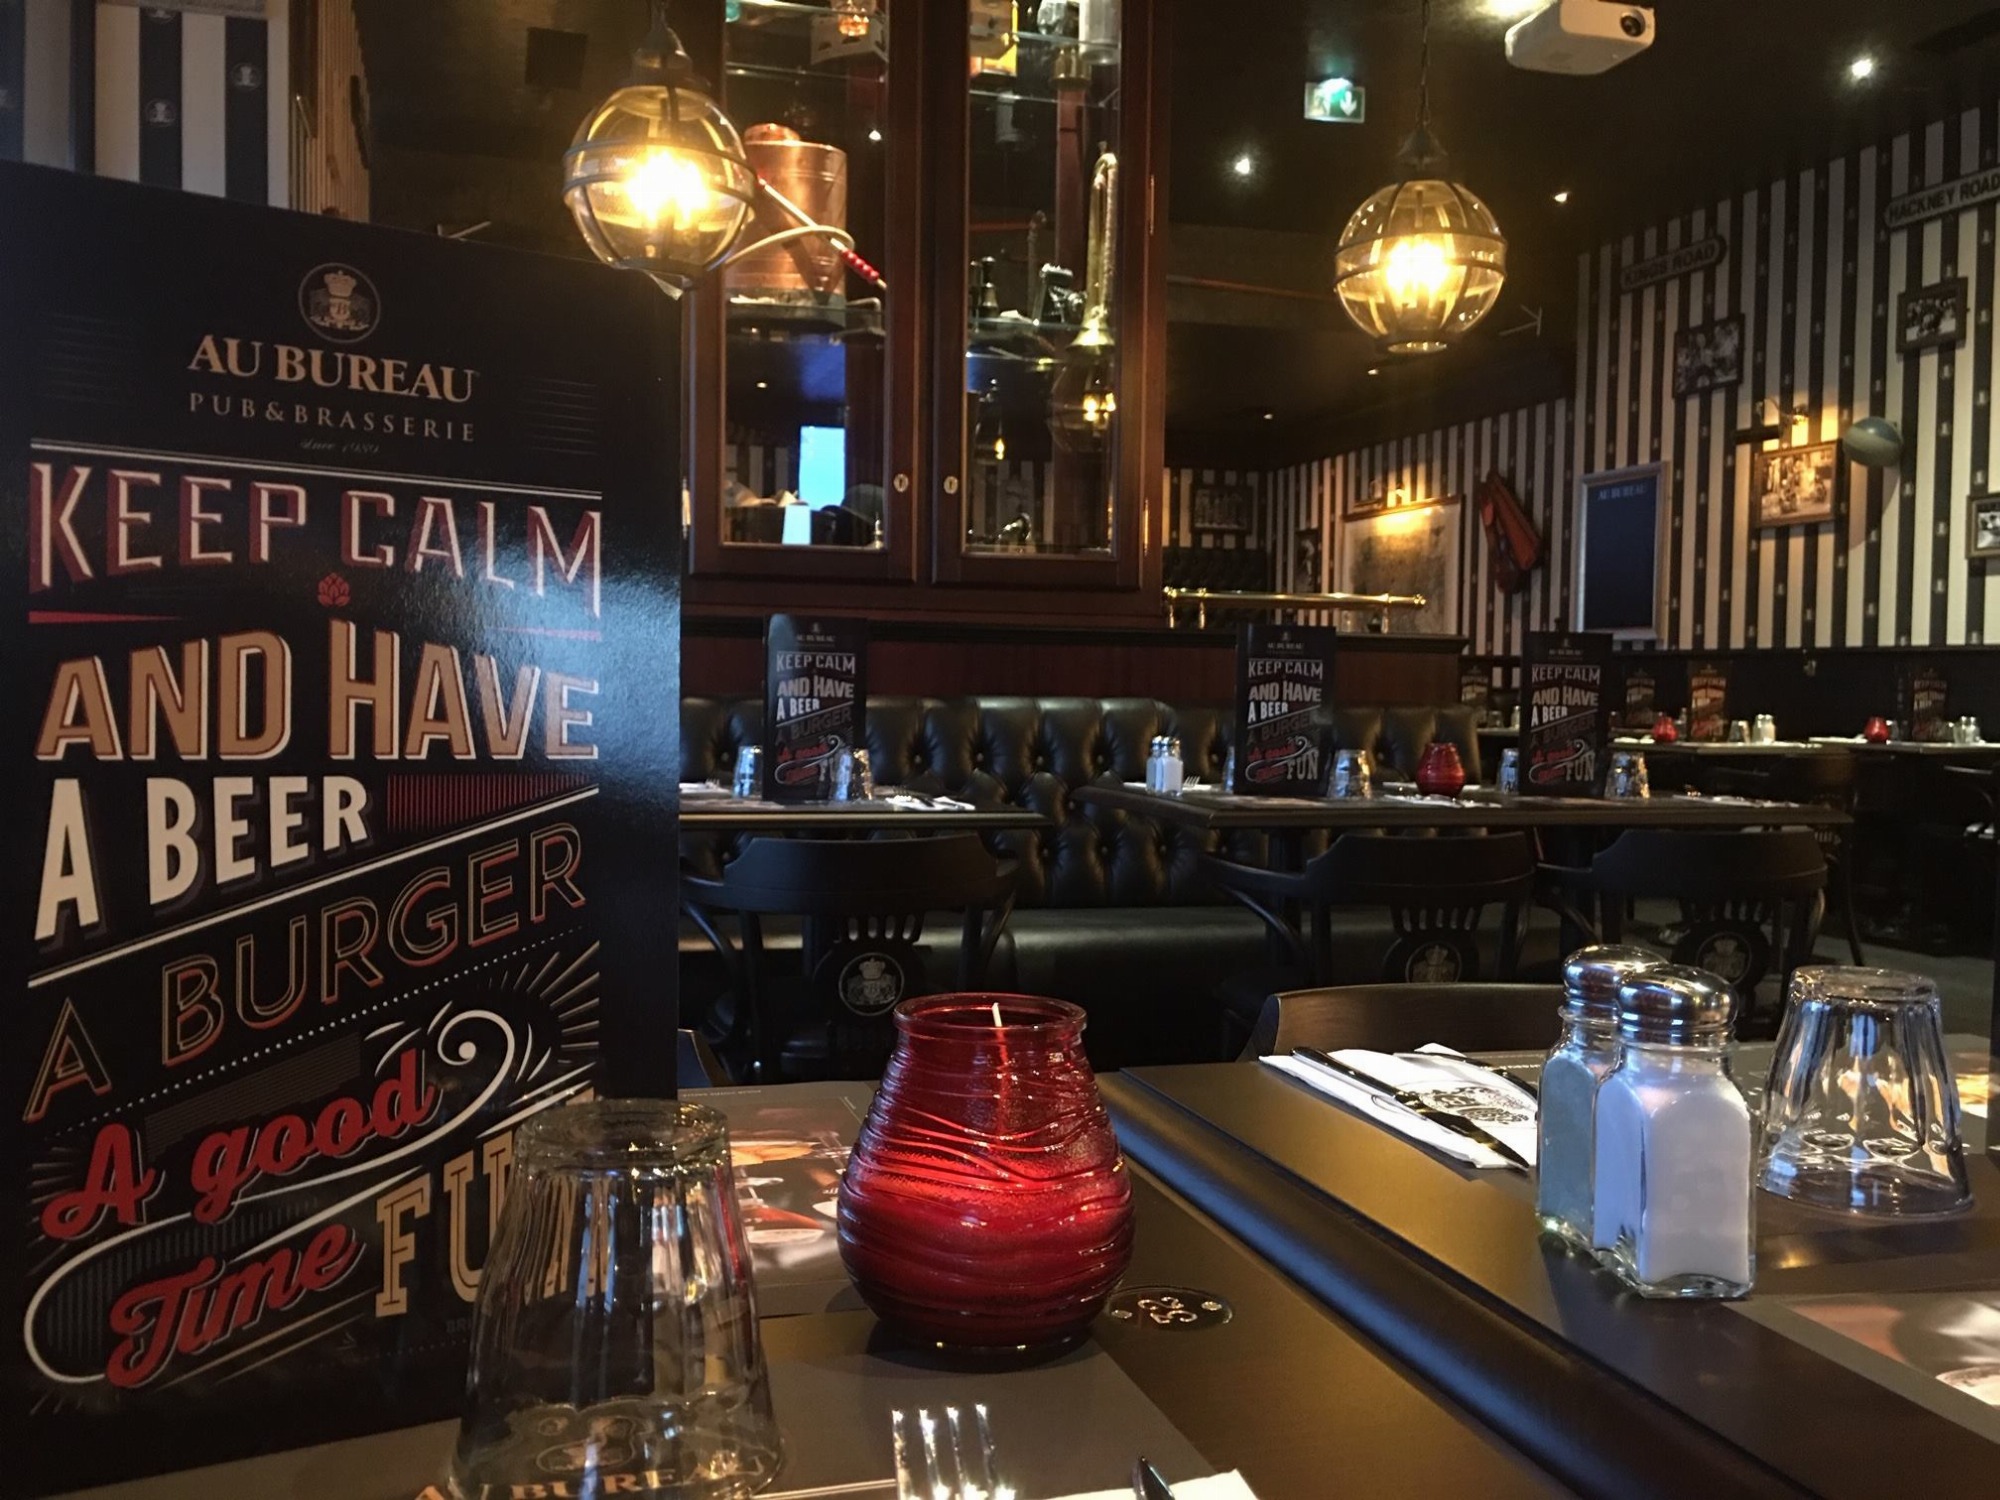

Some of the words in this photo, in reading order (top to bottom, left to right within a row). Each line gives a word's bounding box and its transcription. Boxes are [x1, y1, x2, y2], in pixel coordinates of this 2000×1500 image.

[1889, 187, 1956, 225] HACKNEY
[1960, 172, 2000, 203] ROAD
[188, 335, 263, 377] AU
[274, 344, 475, 402] BUREAU
[29, 462, 307, 593] KEEP
[340, 490, 601, 618] CALM
[776, 654, 813, 674] KEEP
[815, 654, 855, 675] CALM
[1248, 660, 1282, 678] KEEP
[1285, 661, 1323, 680] CALM
[1532, 666, 1562, 683] KEEP
[1564, 666, 1600, 685] CALM
[34, 629, 292, 760] AND
[328, 617, 600, 760] HAVE
[777, 678, 810, 697] AND
[813, 674, 854, 698] HAVE
[1249, 682, 1279, 700] AND
[1282, 680, 1322, 702] HAVE
[1532, 687, 1560, 705] AND
[1562, 685, 1599, 706] HAVE
[776, 697, 786, 721] A
[790, 698, 820, 716] BEER
[1247, 702, 1256, 723] A
[1260, 702, 1288, 720] BEER
[1531, 705, 1539, 727] A
[1542, 706, 1568, 723] BEER
[1287, 748, 1320, 780] FUN
[35, 777, 102, 942] A
[147, 776, 370, 905] BEER
[24, 997, 112, 1123] A
[162, 822, 587, 1066] BURGER
[41, 1123, 162, 1240] A
[190, 1048, 440, 1224] good
[107, 1224, 362, 1388] Time
